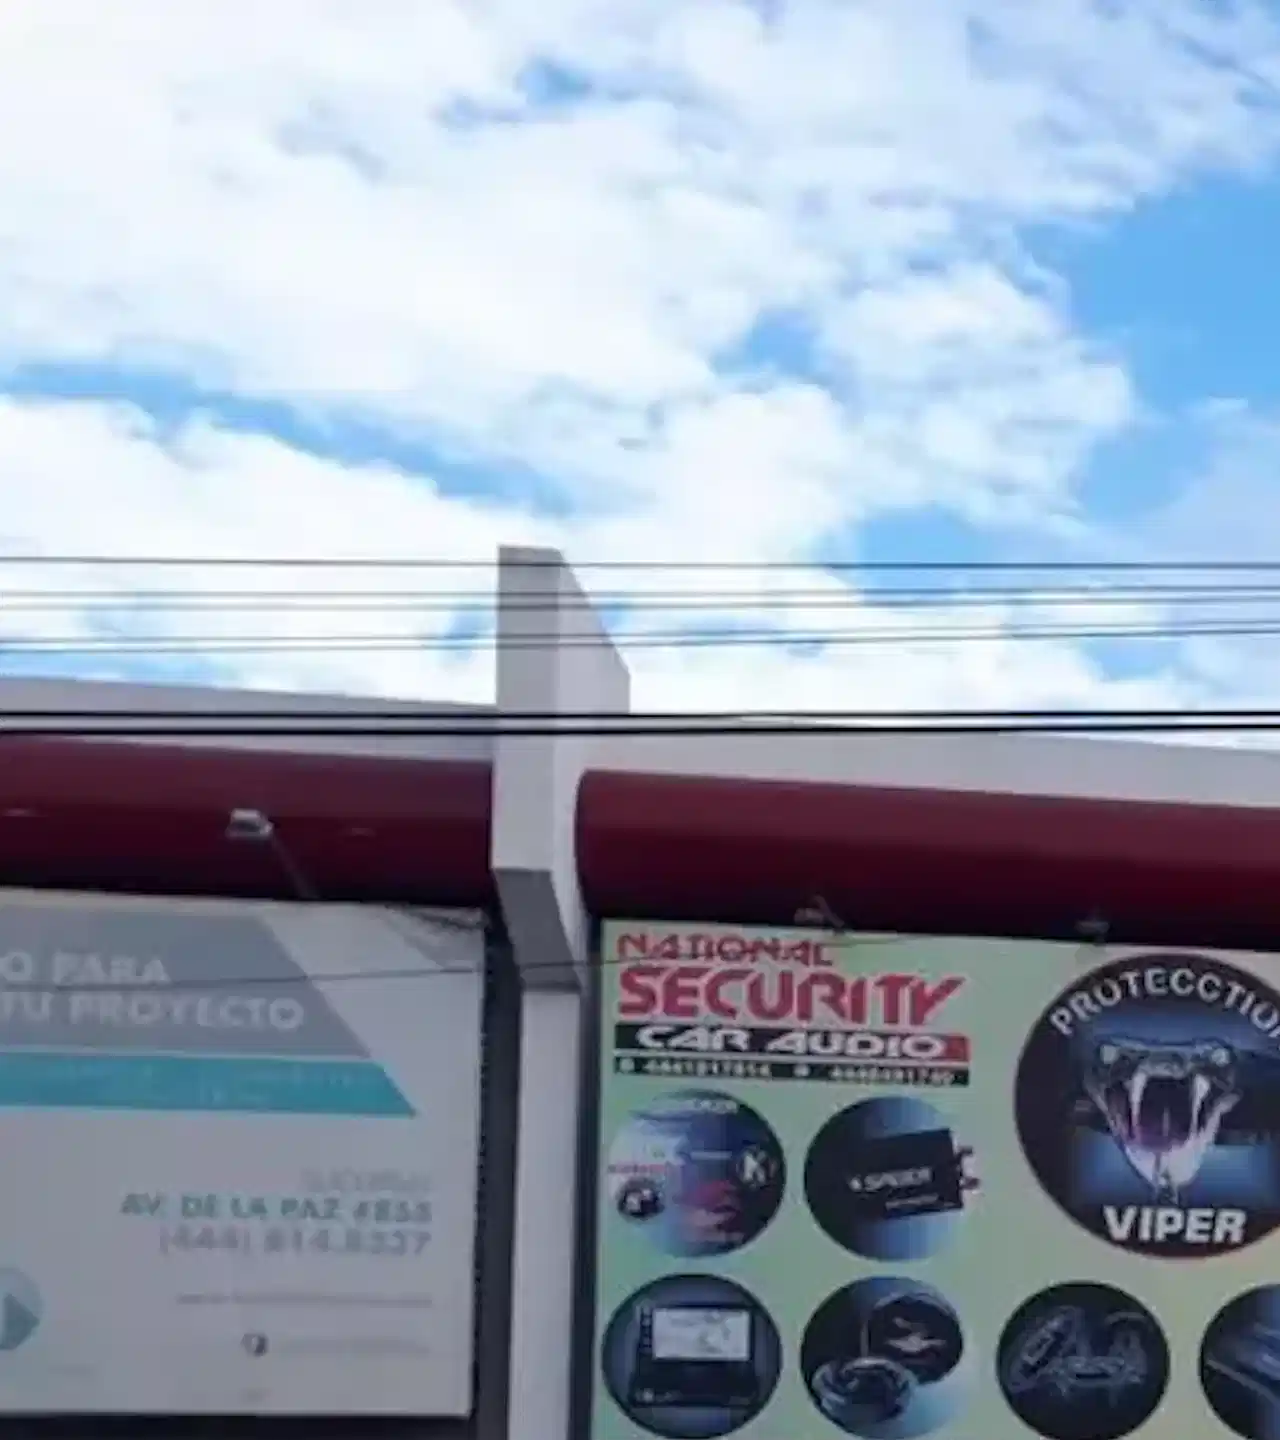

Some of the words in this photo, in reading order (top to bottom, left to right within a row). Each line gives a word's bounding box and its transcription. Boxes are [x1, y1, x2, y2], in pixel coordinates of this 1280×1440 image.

[52, 952, 172, 984] PARA
[616, 933, 834, 967] NATIONAL
[67, 992, 305, 1031] PROYECTO
[617, 967, 967, 1026] SECURITY
[637, 1023, 751, 1052] CAR
[766, 1031, 943, 1059] AUDIO
[181, 1193, 218, 1218] DE
[231, 1196, 268, 1220] LA
[280, 1197, 340, 1221] PAZ
[1102, 1204, 1248, 1244] VIPER
